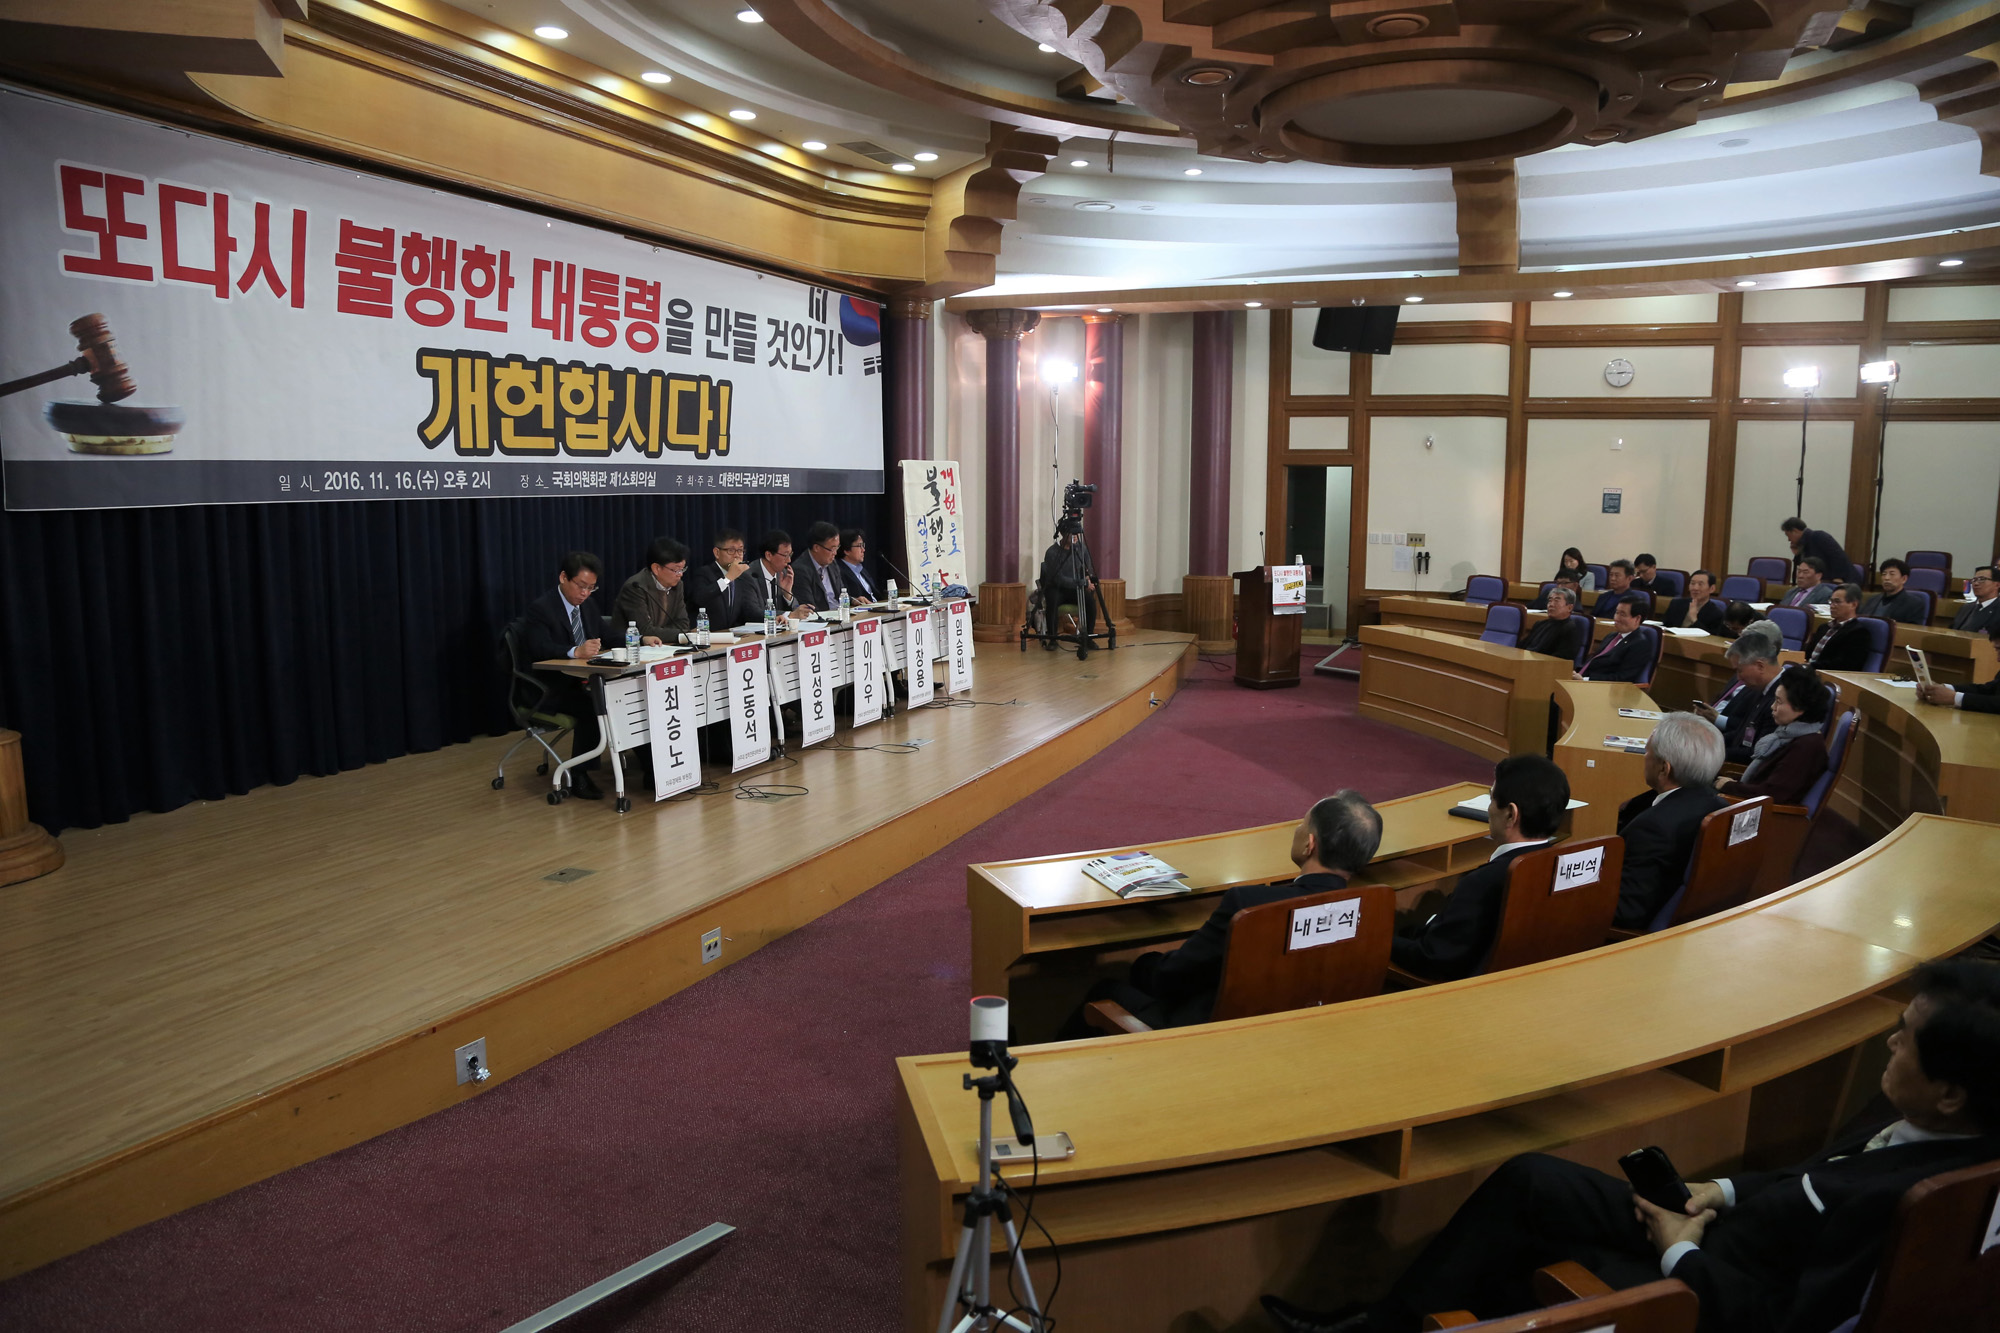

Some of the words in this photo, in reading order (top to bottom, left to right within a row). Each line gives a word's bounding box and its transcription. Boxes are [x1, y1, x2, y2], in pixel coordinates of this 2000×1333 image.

[60, 164, 308, 309] 또다시
[335, 218, 515, 332] 불행한
[532, 257, 694, 355] 대통령을
[706, 305, 758, 364] 만들
[766, 317, 844, 376] 것인가!
[419, 351, 731, 456] 개헌합시다!
[324, 471, 364, 490] 2016.
[369, 471, 390, 490] 11.
[395, 470, 439, 491] 16.(수)
[443, 470, 468, 490] 오후
[472, 470, 491, 490] 2시
[552, 470, 607, 488] 국회의원회관
[609, 471, 657, 488] 제1소회의실
[719, 472, 790, 488] 대한민국살리기포럼
[663, 664, 677, 676] 토론
[741, 649, 753, 659] 토론
[863, 639, 873, 704] 이기우
[915, 627, 924, 688] 이창용
[955, 618, 965, 675] 임승빈
[742, 668, 757, 743] 오동석
[810, 651, 824, 721] 김성호
[664, 684, 685, 769] 최승노
[1560, 857, 1597, 880] 내빈석
[1294, 910, 1354, 936] 내빈석
